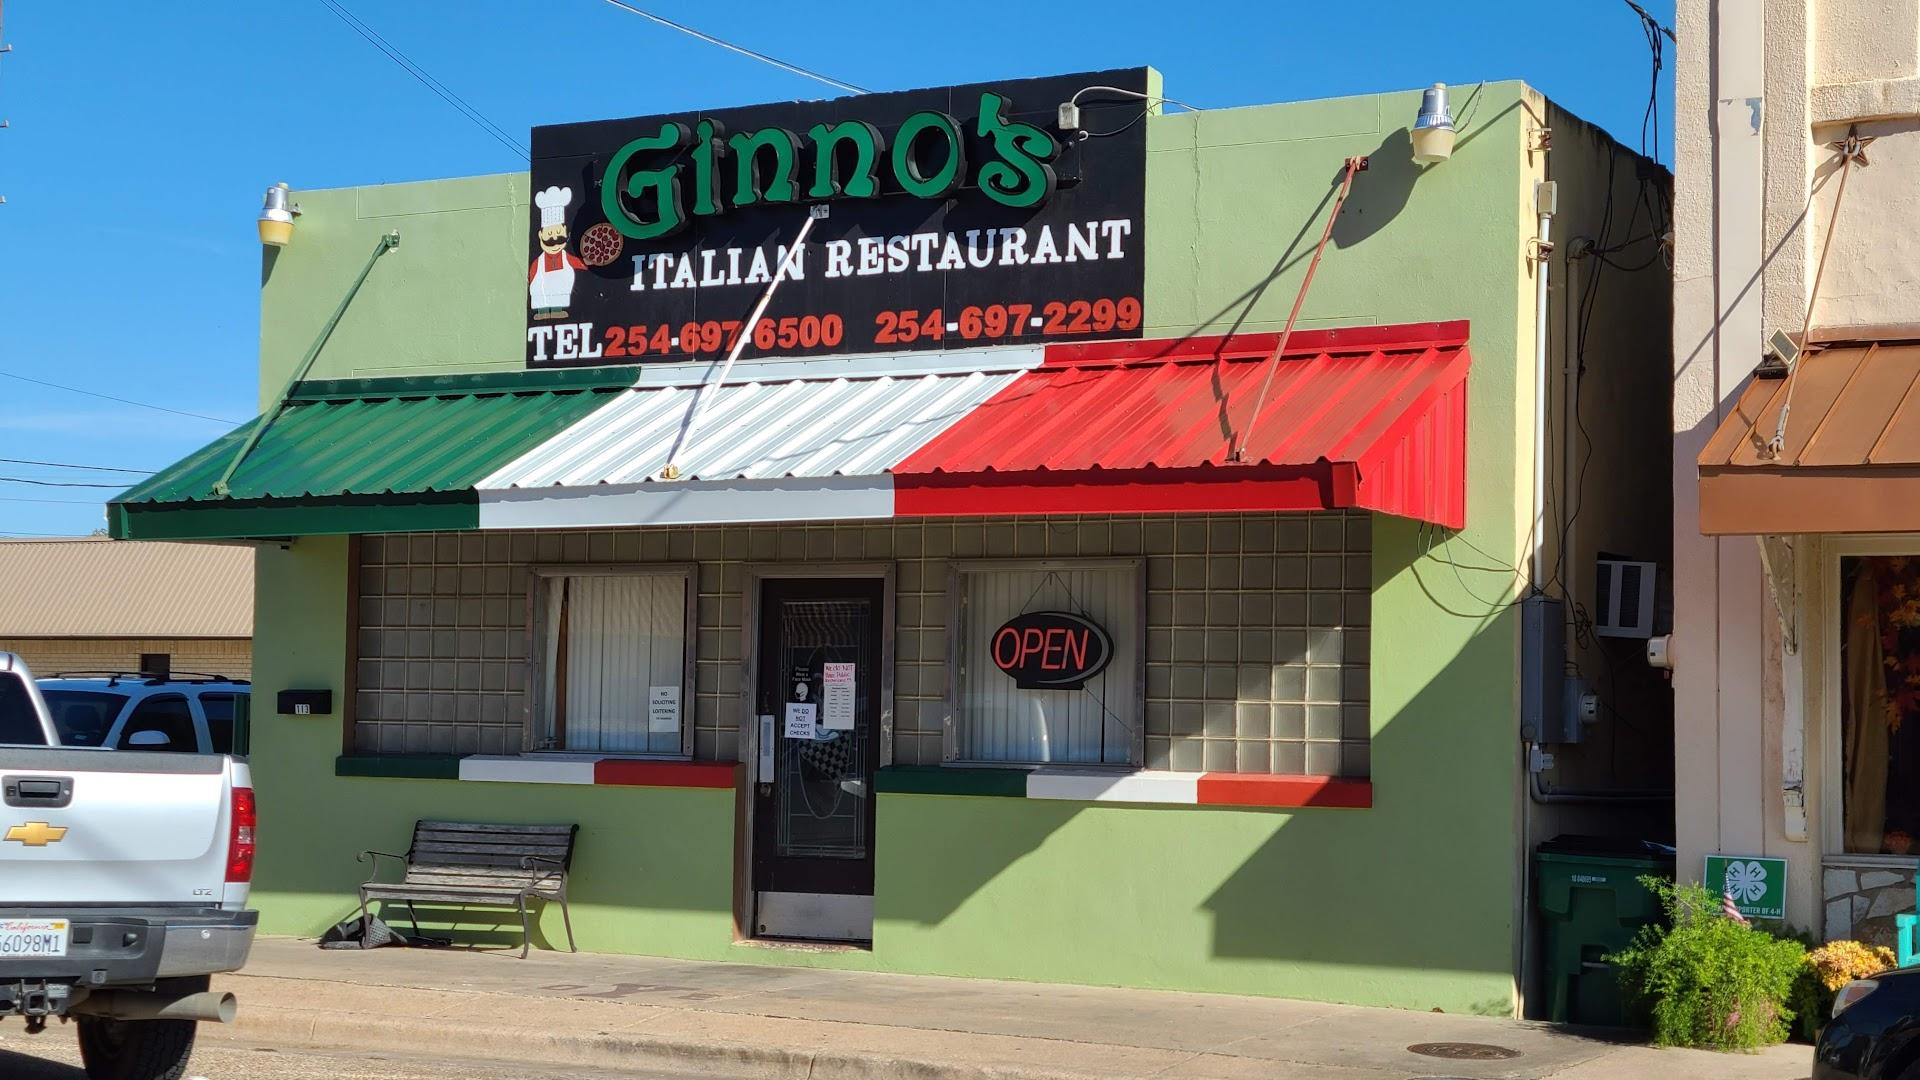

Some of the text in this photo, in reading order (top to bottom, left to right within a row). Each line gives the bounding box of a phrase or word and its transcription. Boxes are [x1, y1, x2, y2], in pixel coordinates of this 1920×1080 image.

[601, 92, 1059, 239] Ginno's
[630, 219, 1131, 291] ITALIAN RESTAURANT
[528, 296, 1142, 361] TEL 254-697-6500 254-697-2299
[994, 627, 1089, 670] OPEN
[297, 704, 309, 714] 113
[193, 888, 212, 896] LTZ
[0, 934, 60, 953] 6098M1
